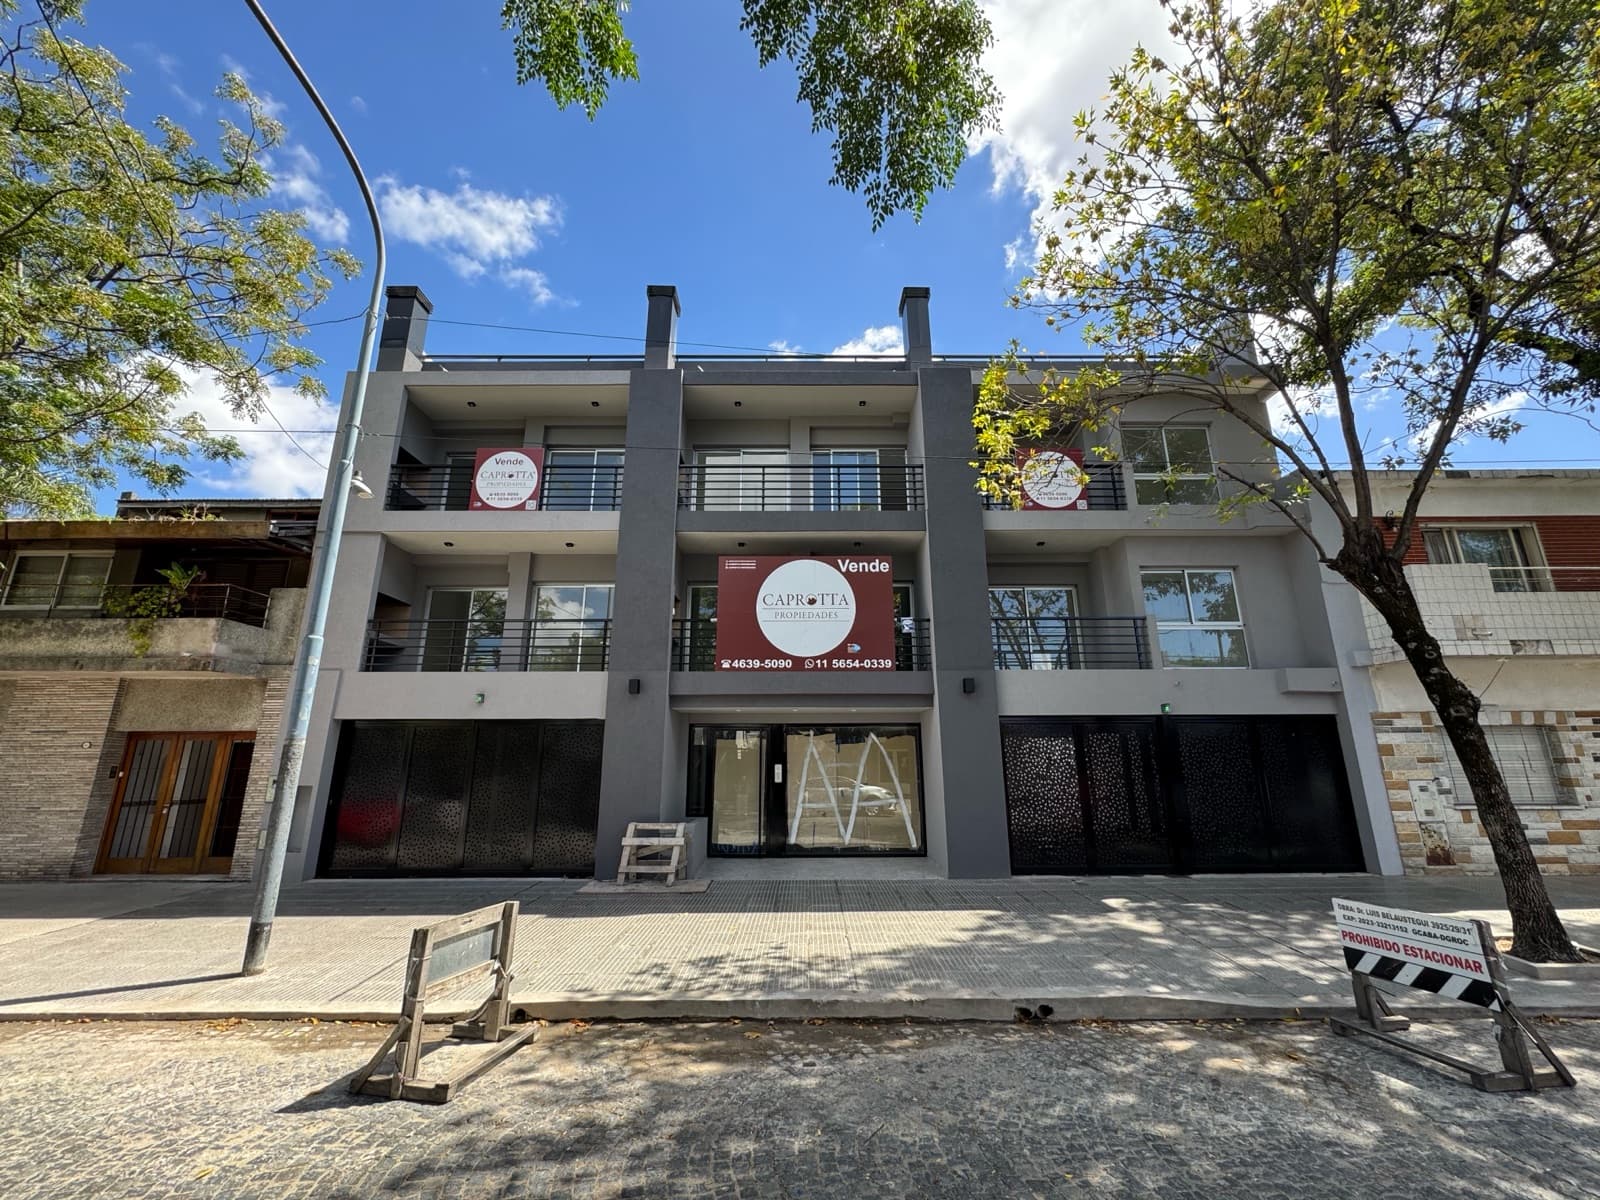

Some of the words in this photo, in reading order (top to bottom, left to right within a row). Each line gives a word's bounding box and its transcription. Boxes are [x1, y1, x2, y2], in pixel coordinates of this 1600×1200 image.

[495, 458, 524, 466] Vende
[837, 559, 890, 573] Vende
[762, 593, 849, 607] CAPROTTA
[774, 611, 838, 619] PROPIEDADES
[732, 659, 792, 669] 4639-5090
[815, 659, 828, 668] 11
[832, 659, 892, 669] 5654-0339
[1366, 908, 1380, 918] LUIS
[1381, 911, 1430, 928] BELAUSTEGUI
[1341, 929, 1401, 954] PROHIBIDO
[1402, 943, 1485, 975] ESTACIONAR
